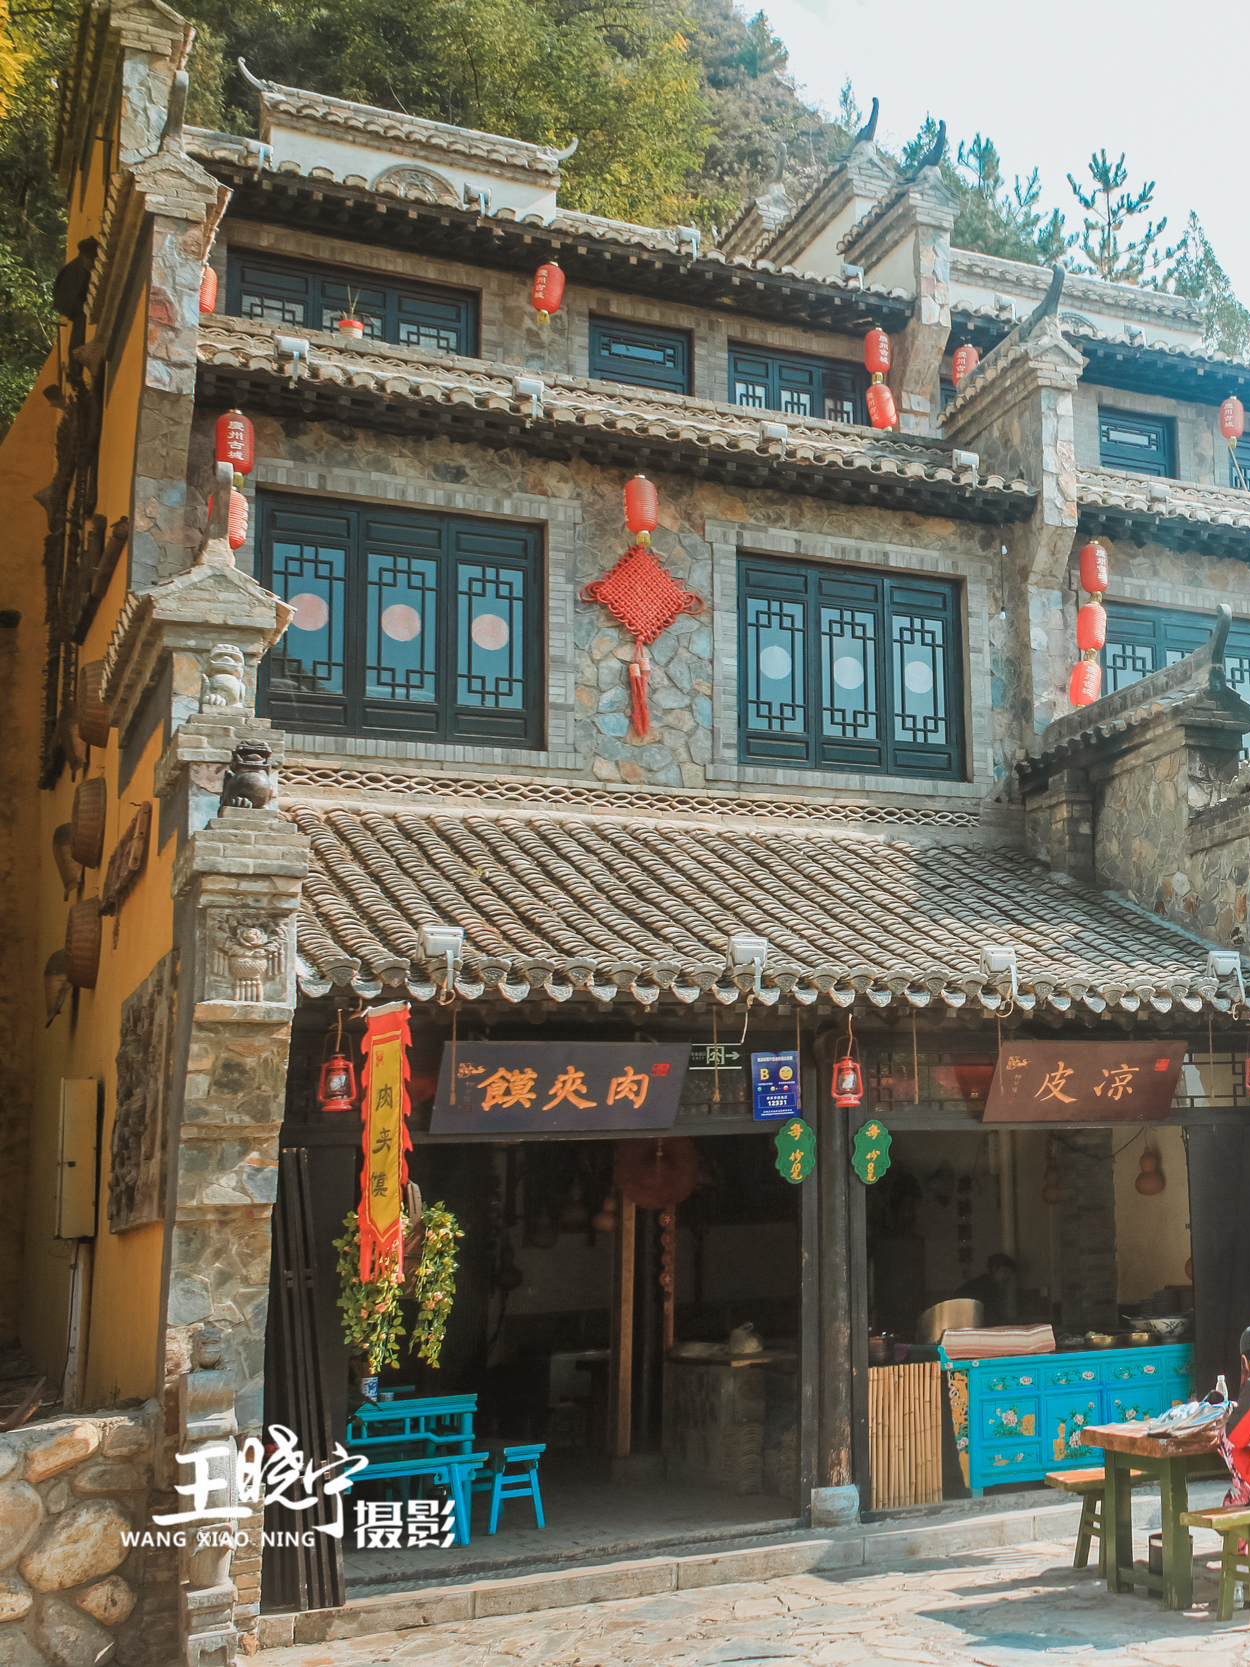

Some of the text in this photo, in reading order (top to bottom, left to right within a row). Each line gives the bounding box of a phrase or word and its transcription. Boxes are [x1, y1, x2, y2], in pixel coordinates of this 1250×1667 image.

[759, 1068, 770, 1081] B
[767, 1099, 788, 1107] 12331
[371, 1083, 394, 1198] 肉夹馍
